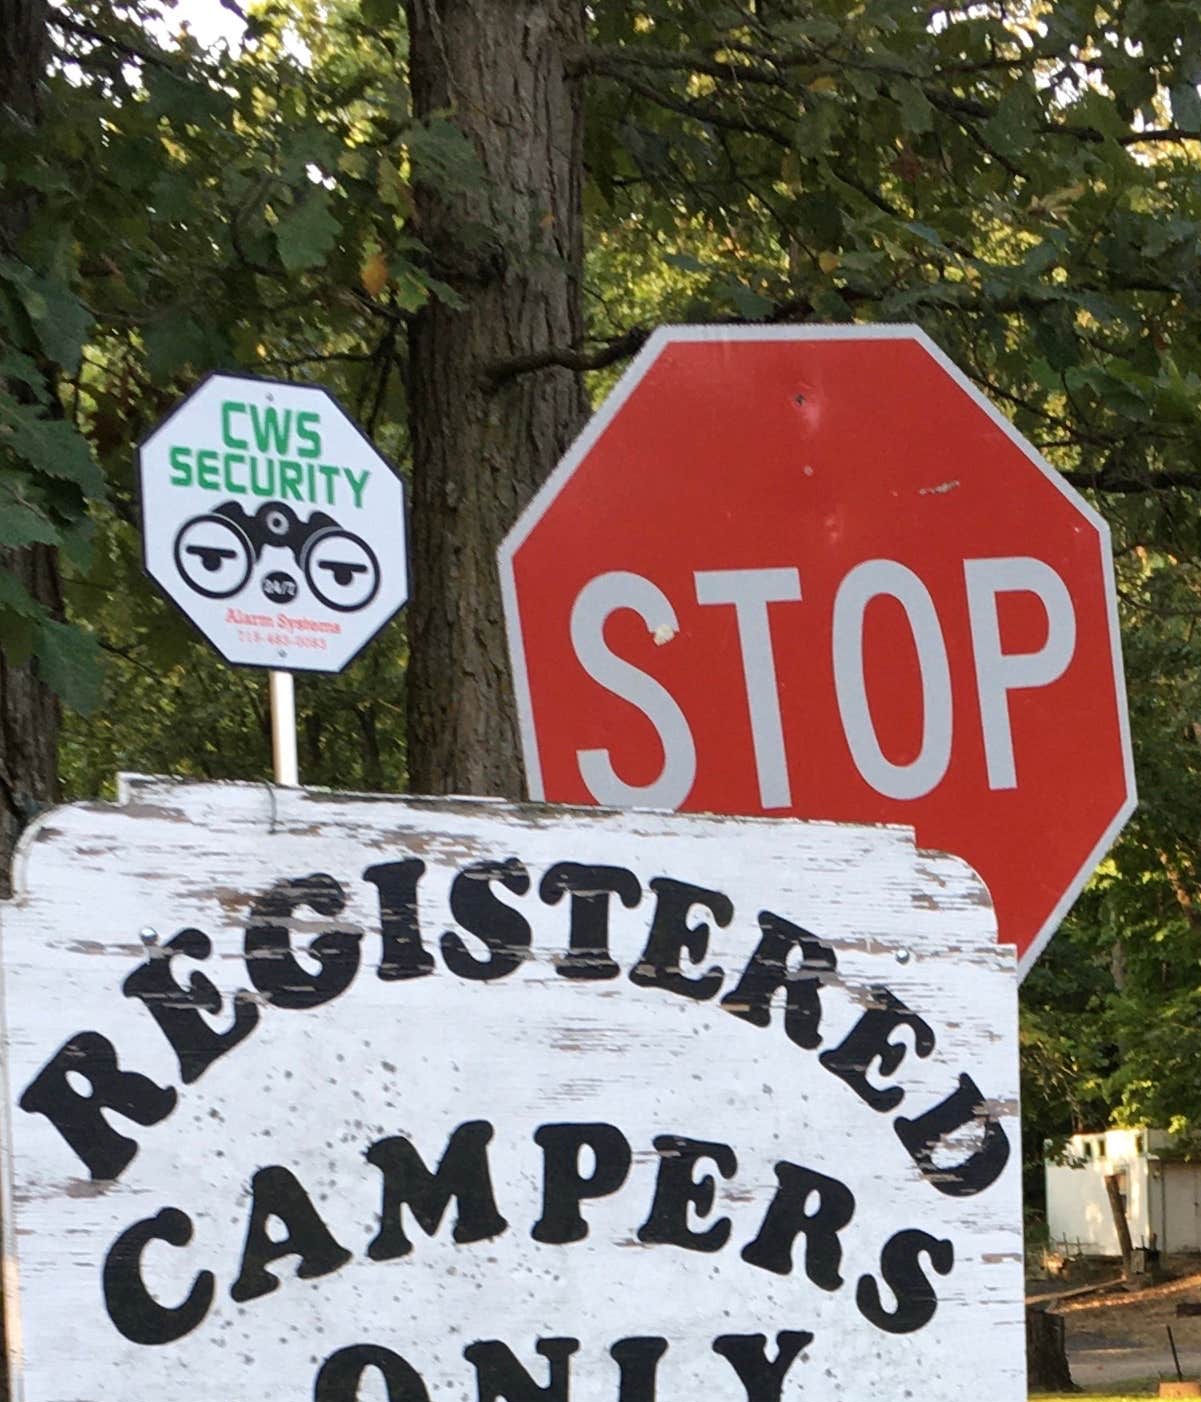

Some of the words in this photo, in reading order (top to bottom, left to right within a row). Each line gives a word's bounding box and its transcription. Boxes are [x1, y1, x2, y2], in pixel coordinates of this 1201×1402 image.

[170, 447, 370, 508] SECURITY
[223, 401, 321, 458] CWS
[226, 609, 273, 626] Alarm
[277, 613, 342, 634] Systems
[570, 556, 1076, 812] STOP
[20, 857, 1011, 1197] REGISTERED
[102, 1120, 955, 1346] CAMPERS
